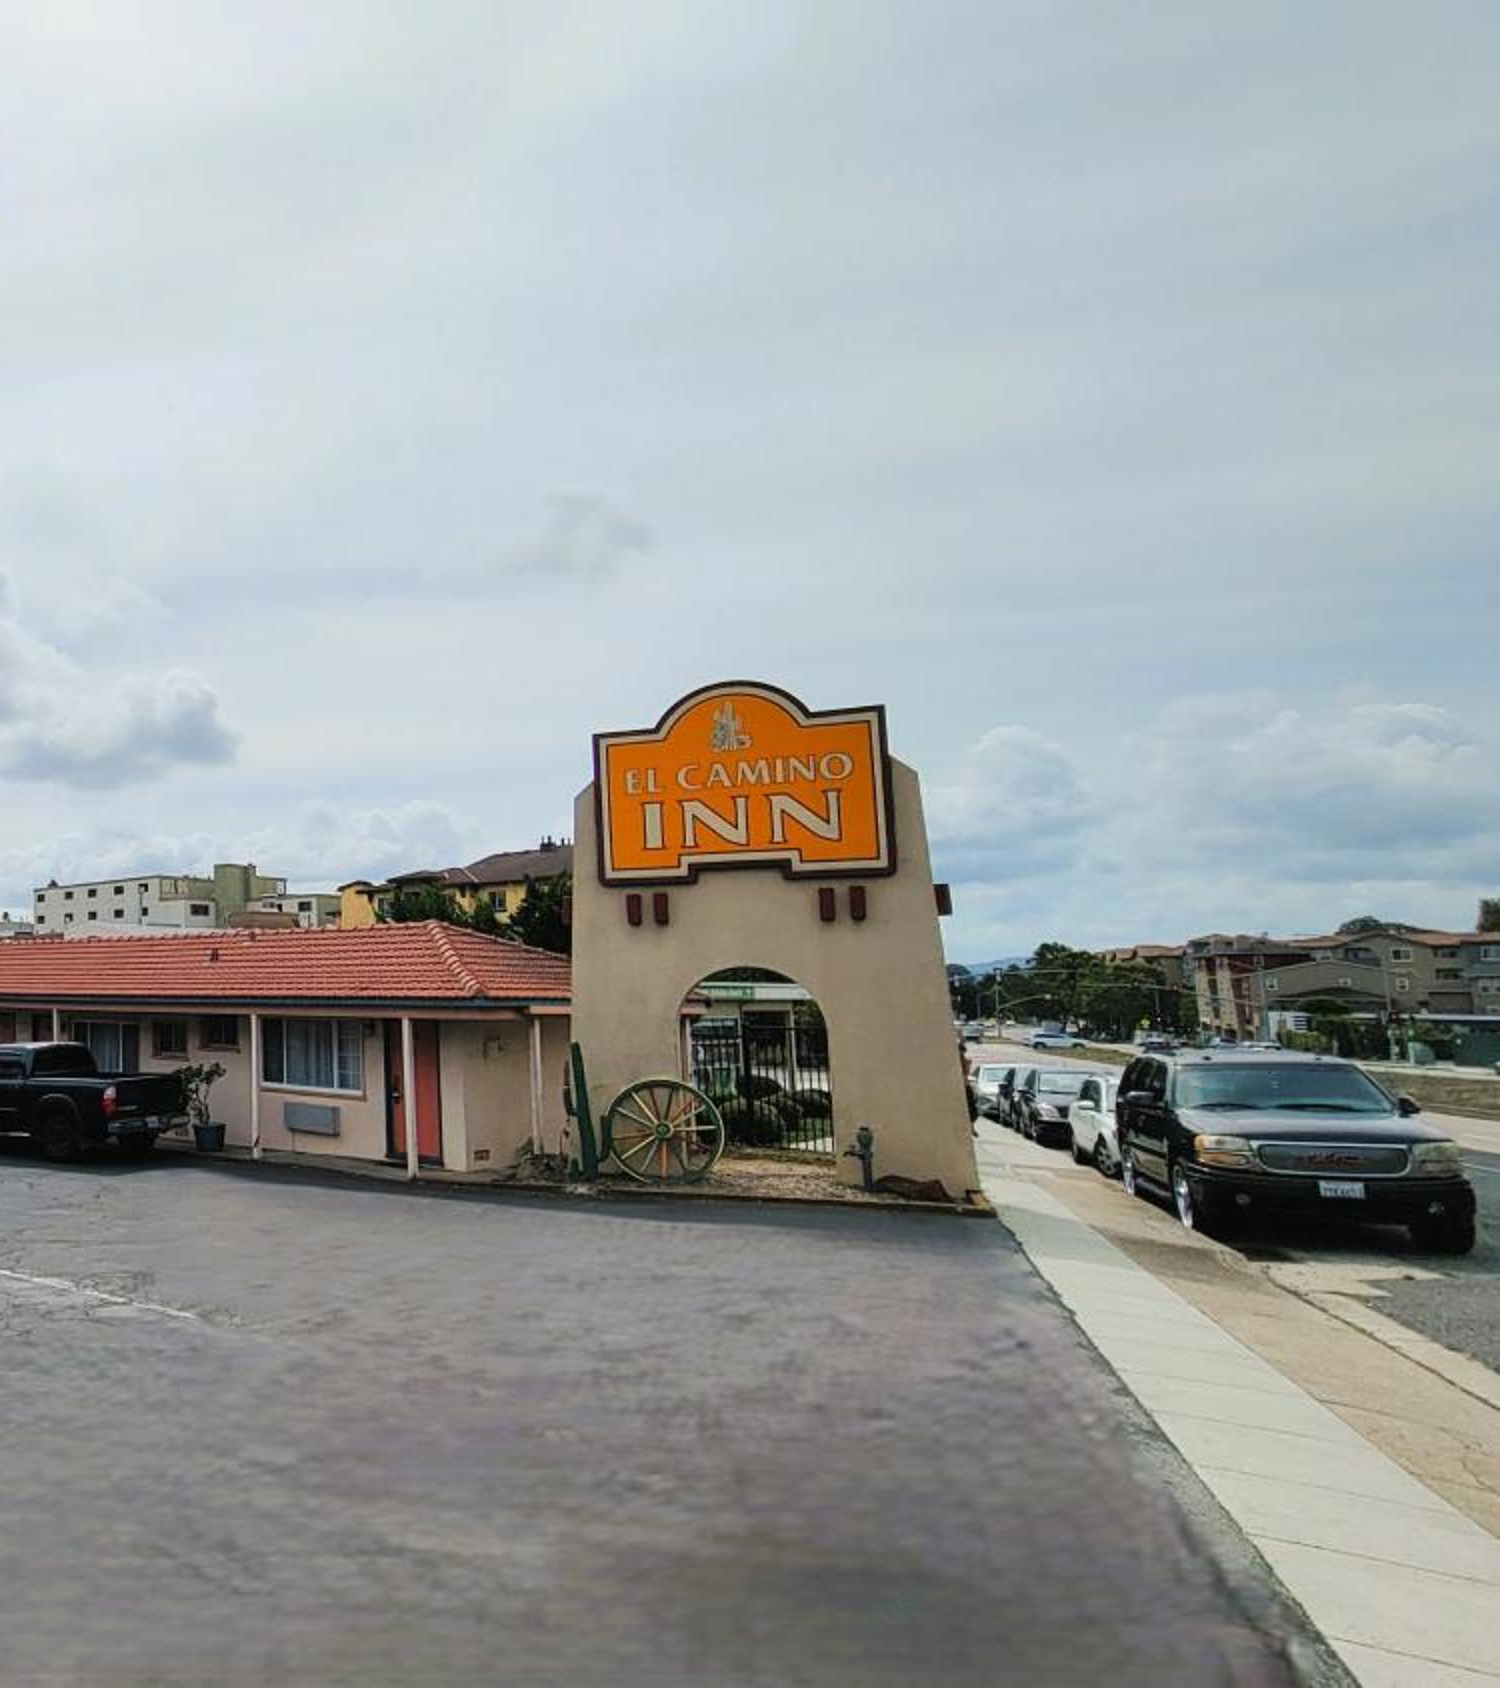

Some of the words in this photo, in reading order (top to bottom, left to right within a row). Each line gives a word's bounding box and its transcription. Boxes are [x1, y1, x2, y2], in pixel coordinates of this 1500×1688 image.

[624, 767, 664, 795] EL
[675, 752, 853, 790] CAMINO
[642, 788, 842, 850] INN
